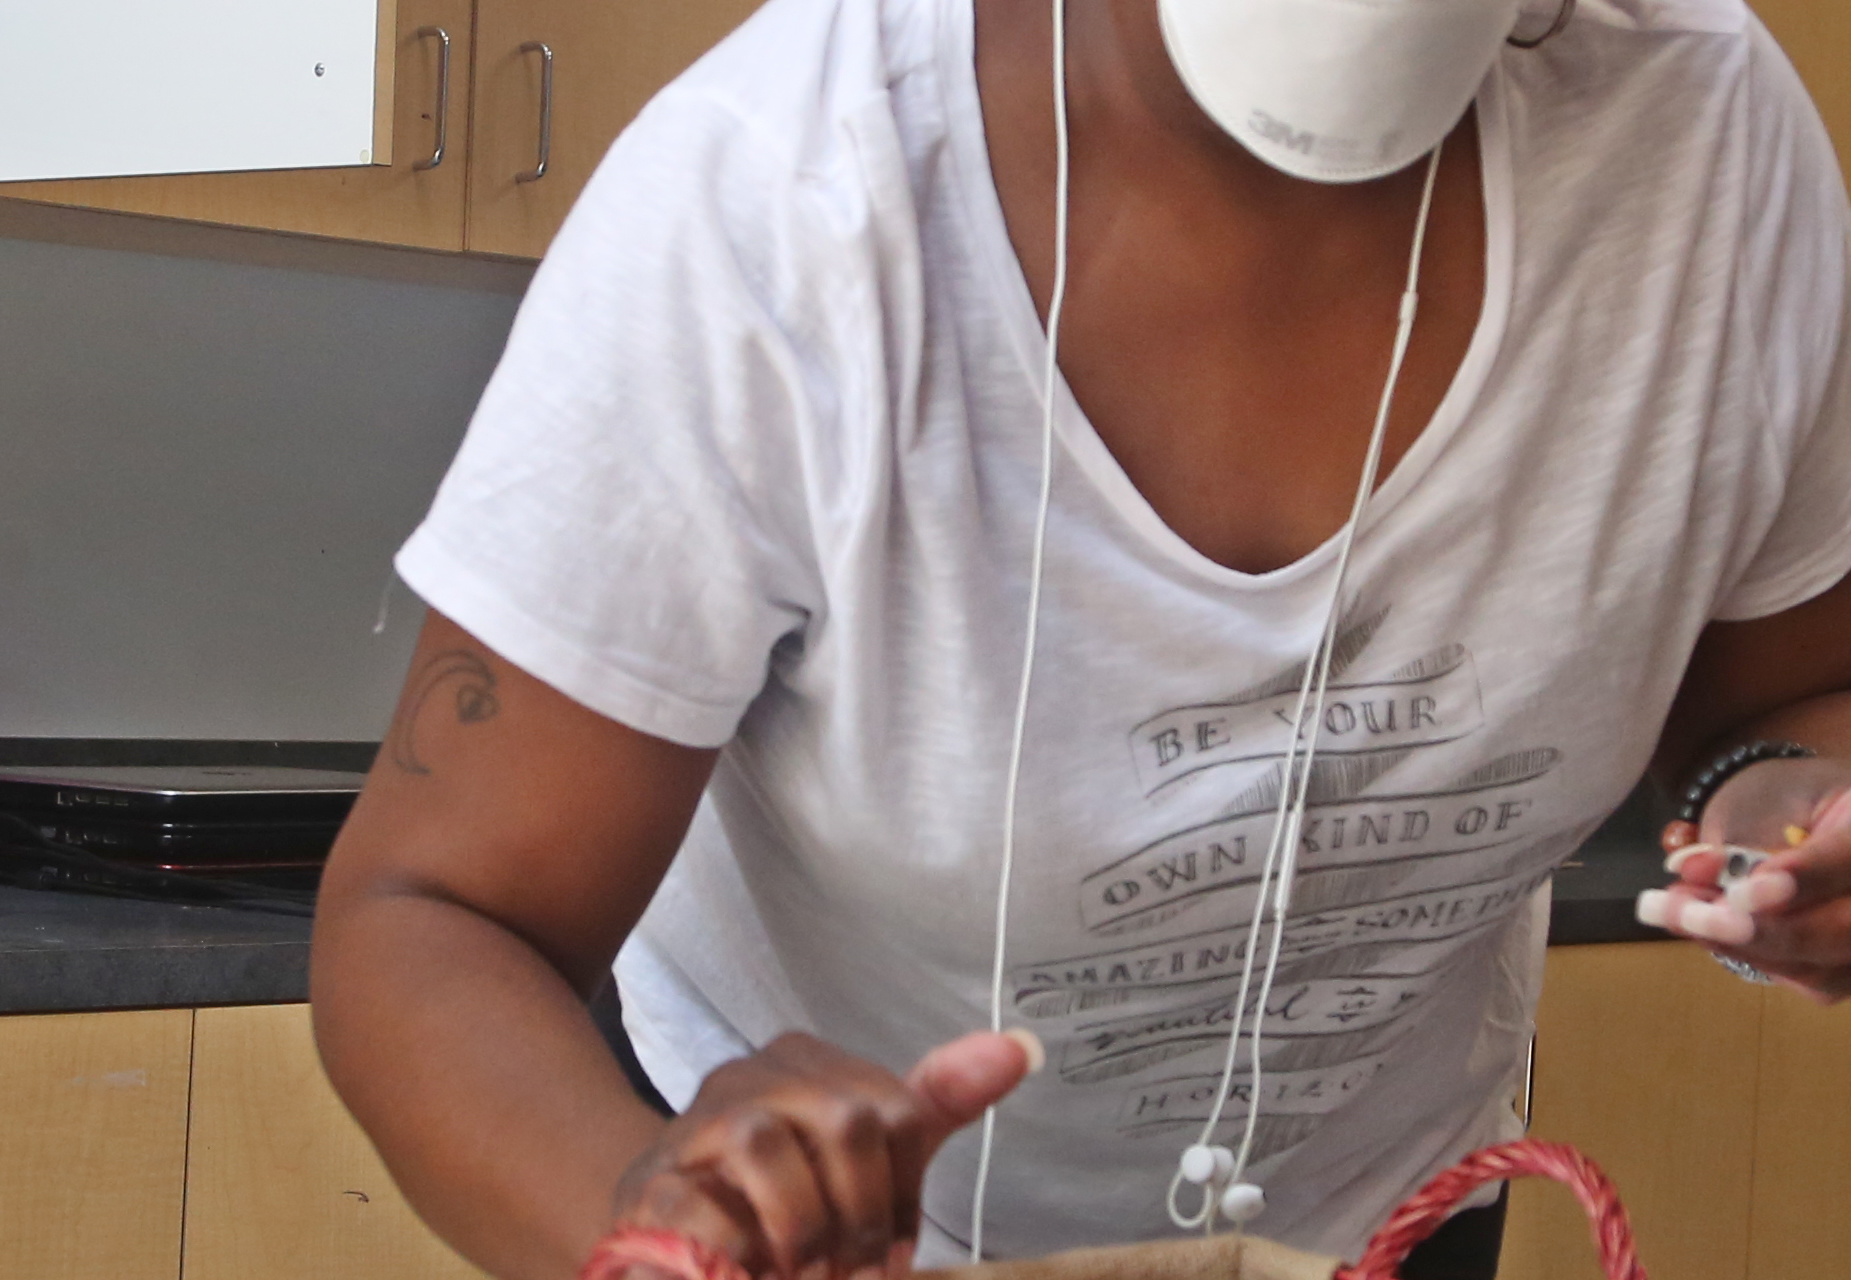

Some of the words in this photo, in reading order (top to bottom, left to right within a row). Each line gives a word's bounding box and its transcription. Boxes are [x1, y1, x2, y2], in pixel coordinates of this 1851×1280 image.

[1147, 719, 1231, 768] BE
[1273, 694, 1439, 740] YOUR
[1102, 835, 1249, 908] OWN
[1453, 797, 1533, 835] OF
